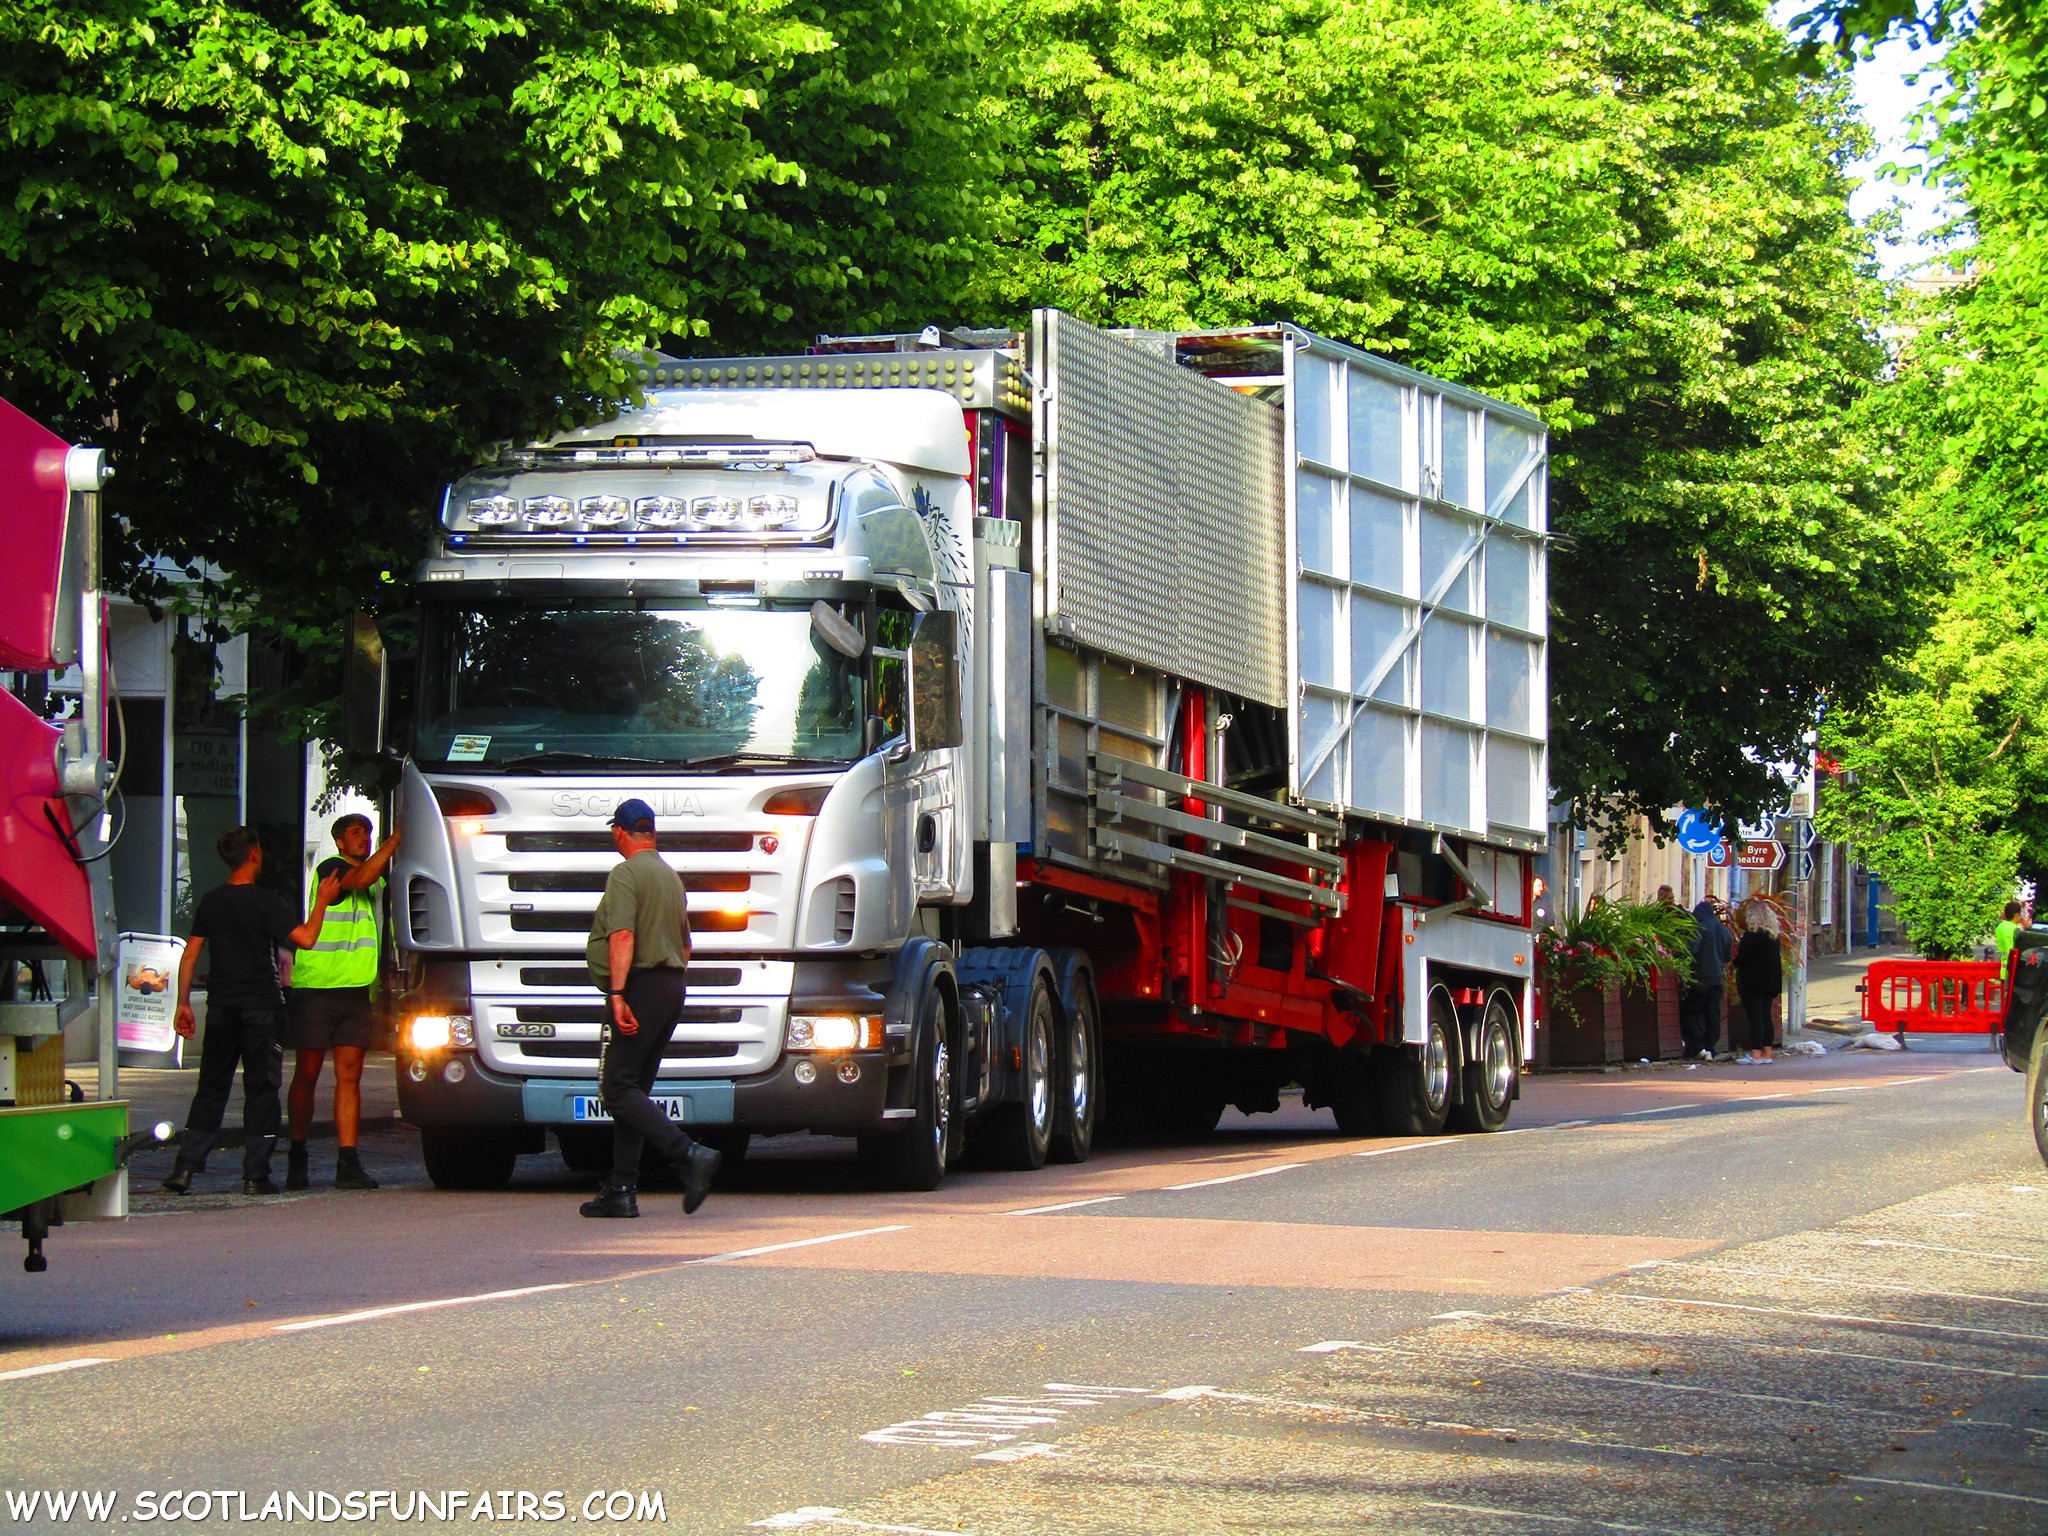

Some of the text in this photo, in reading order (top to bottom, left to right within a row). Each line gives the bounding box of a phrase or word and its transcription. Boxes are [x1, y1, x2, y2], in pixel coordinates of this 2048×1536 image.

[1747, 845, 1768, 855] Byre
[147, 1005, 166, 1013] MASSAGE
[499, 1025, 553, 1037] R 420
